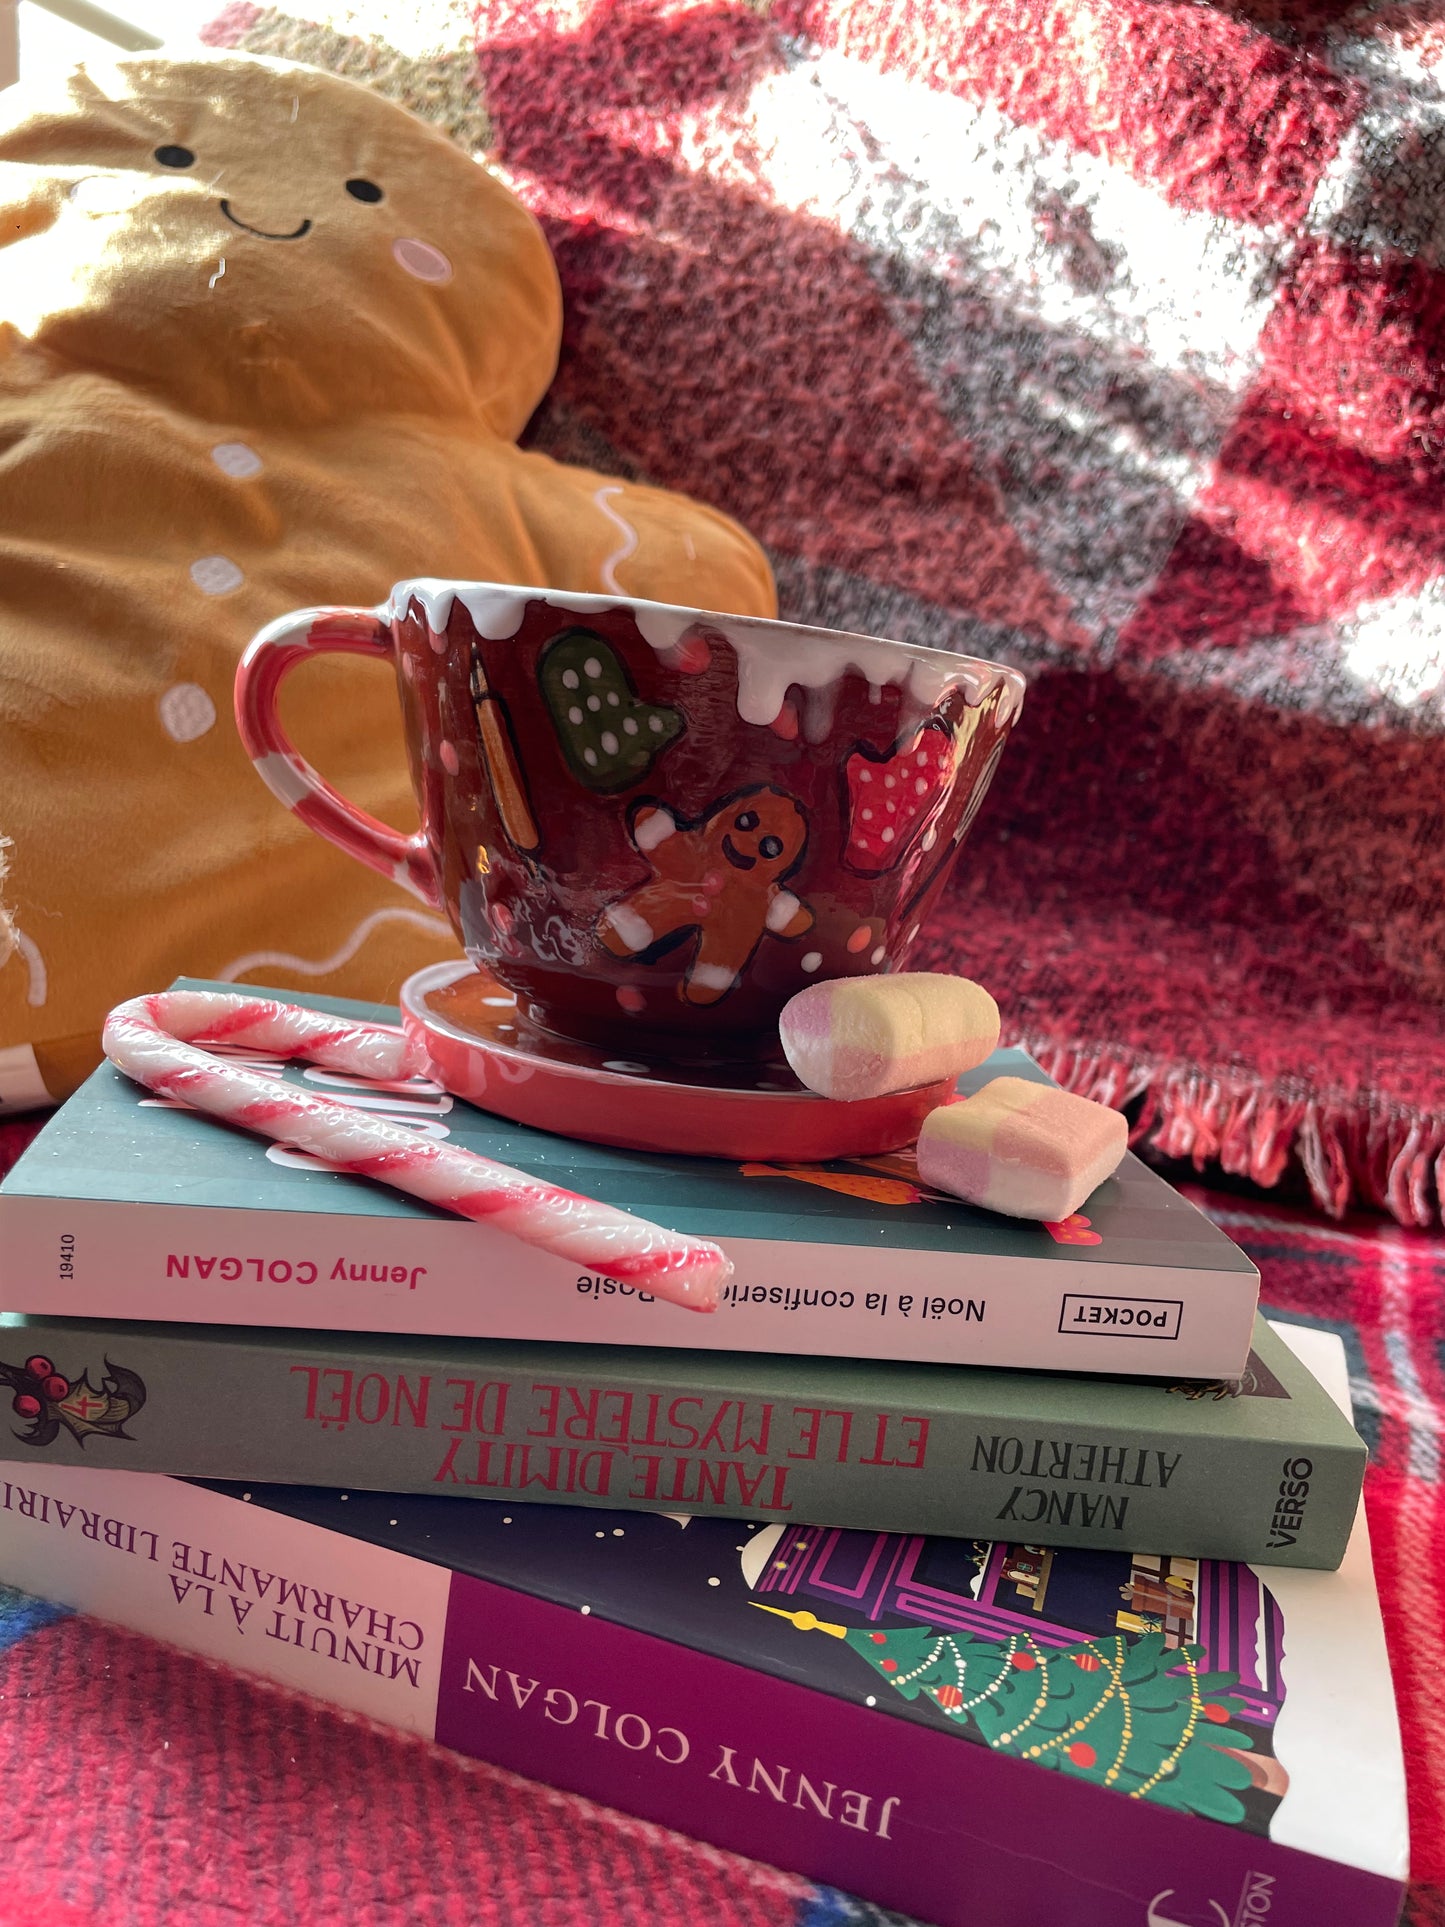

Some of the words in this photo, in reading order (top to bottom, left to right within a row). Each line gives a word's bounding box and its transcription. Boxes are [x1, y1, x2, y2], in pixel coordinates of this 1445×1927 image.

[60, 1234, 75, 1280] 19410
[166, 1254, 318, 1284] COLGAN
[329, 1258, 427, 1289] Jenny
[724, 1285, 855, 1310] confiseri
[865, 1293, 886, 1315] la
[898, 1295, 914, 1320] à
[922, 1296, 986, 1322] Noël
[1073, 1306, 1167, 1327] POCKET
[290, 1366, 432, 1432] NOËL
[441, 1379, 512, 1436] DE
[526, 1384, 775, 1456] MYSTÈRE
[787, 1407, 854, 1463] LE
[859, 1413, 931, 1469] ET
[970, 1435, 1183, 1488] ATHERTON
[433, 1437, 615, 1496] DIMITY
[629, 1455, 793, 1511] TANTE
[0, 1480, 159, 1562] LIBRAIRI
[995, 1486, 1130, 1530] NANCY
[1266, 1457, 1313, 1549] VERSO
[168, 1573, 214, 1615] LA
[172, 1541, 424, 1651] CHARMANTE
[229, 1594, 254, 1635] À
[266, 1610, 422, 1688] MINUIT
[463, 1658, 690, 1764] COLGAN
[708, 1744, 900, 1840] JENNY
